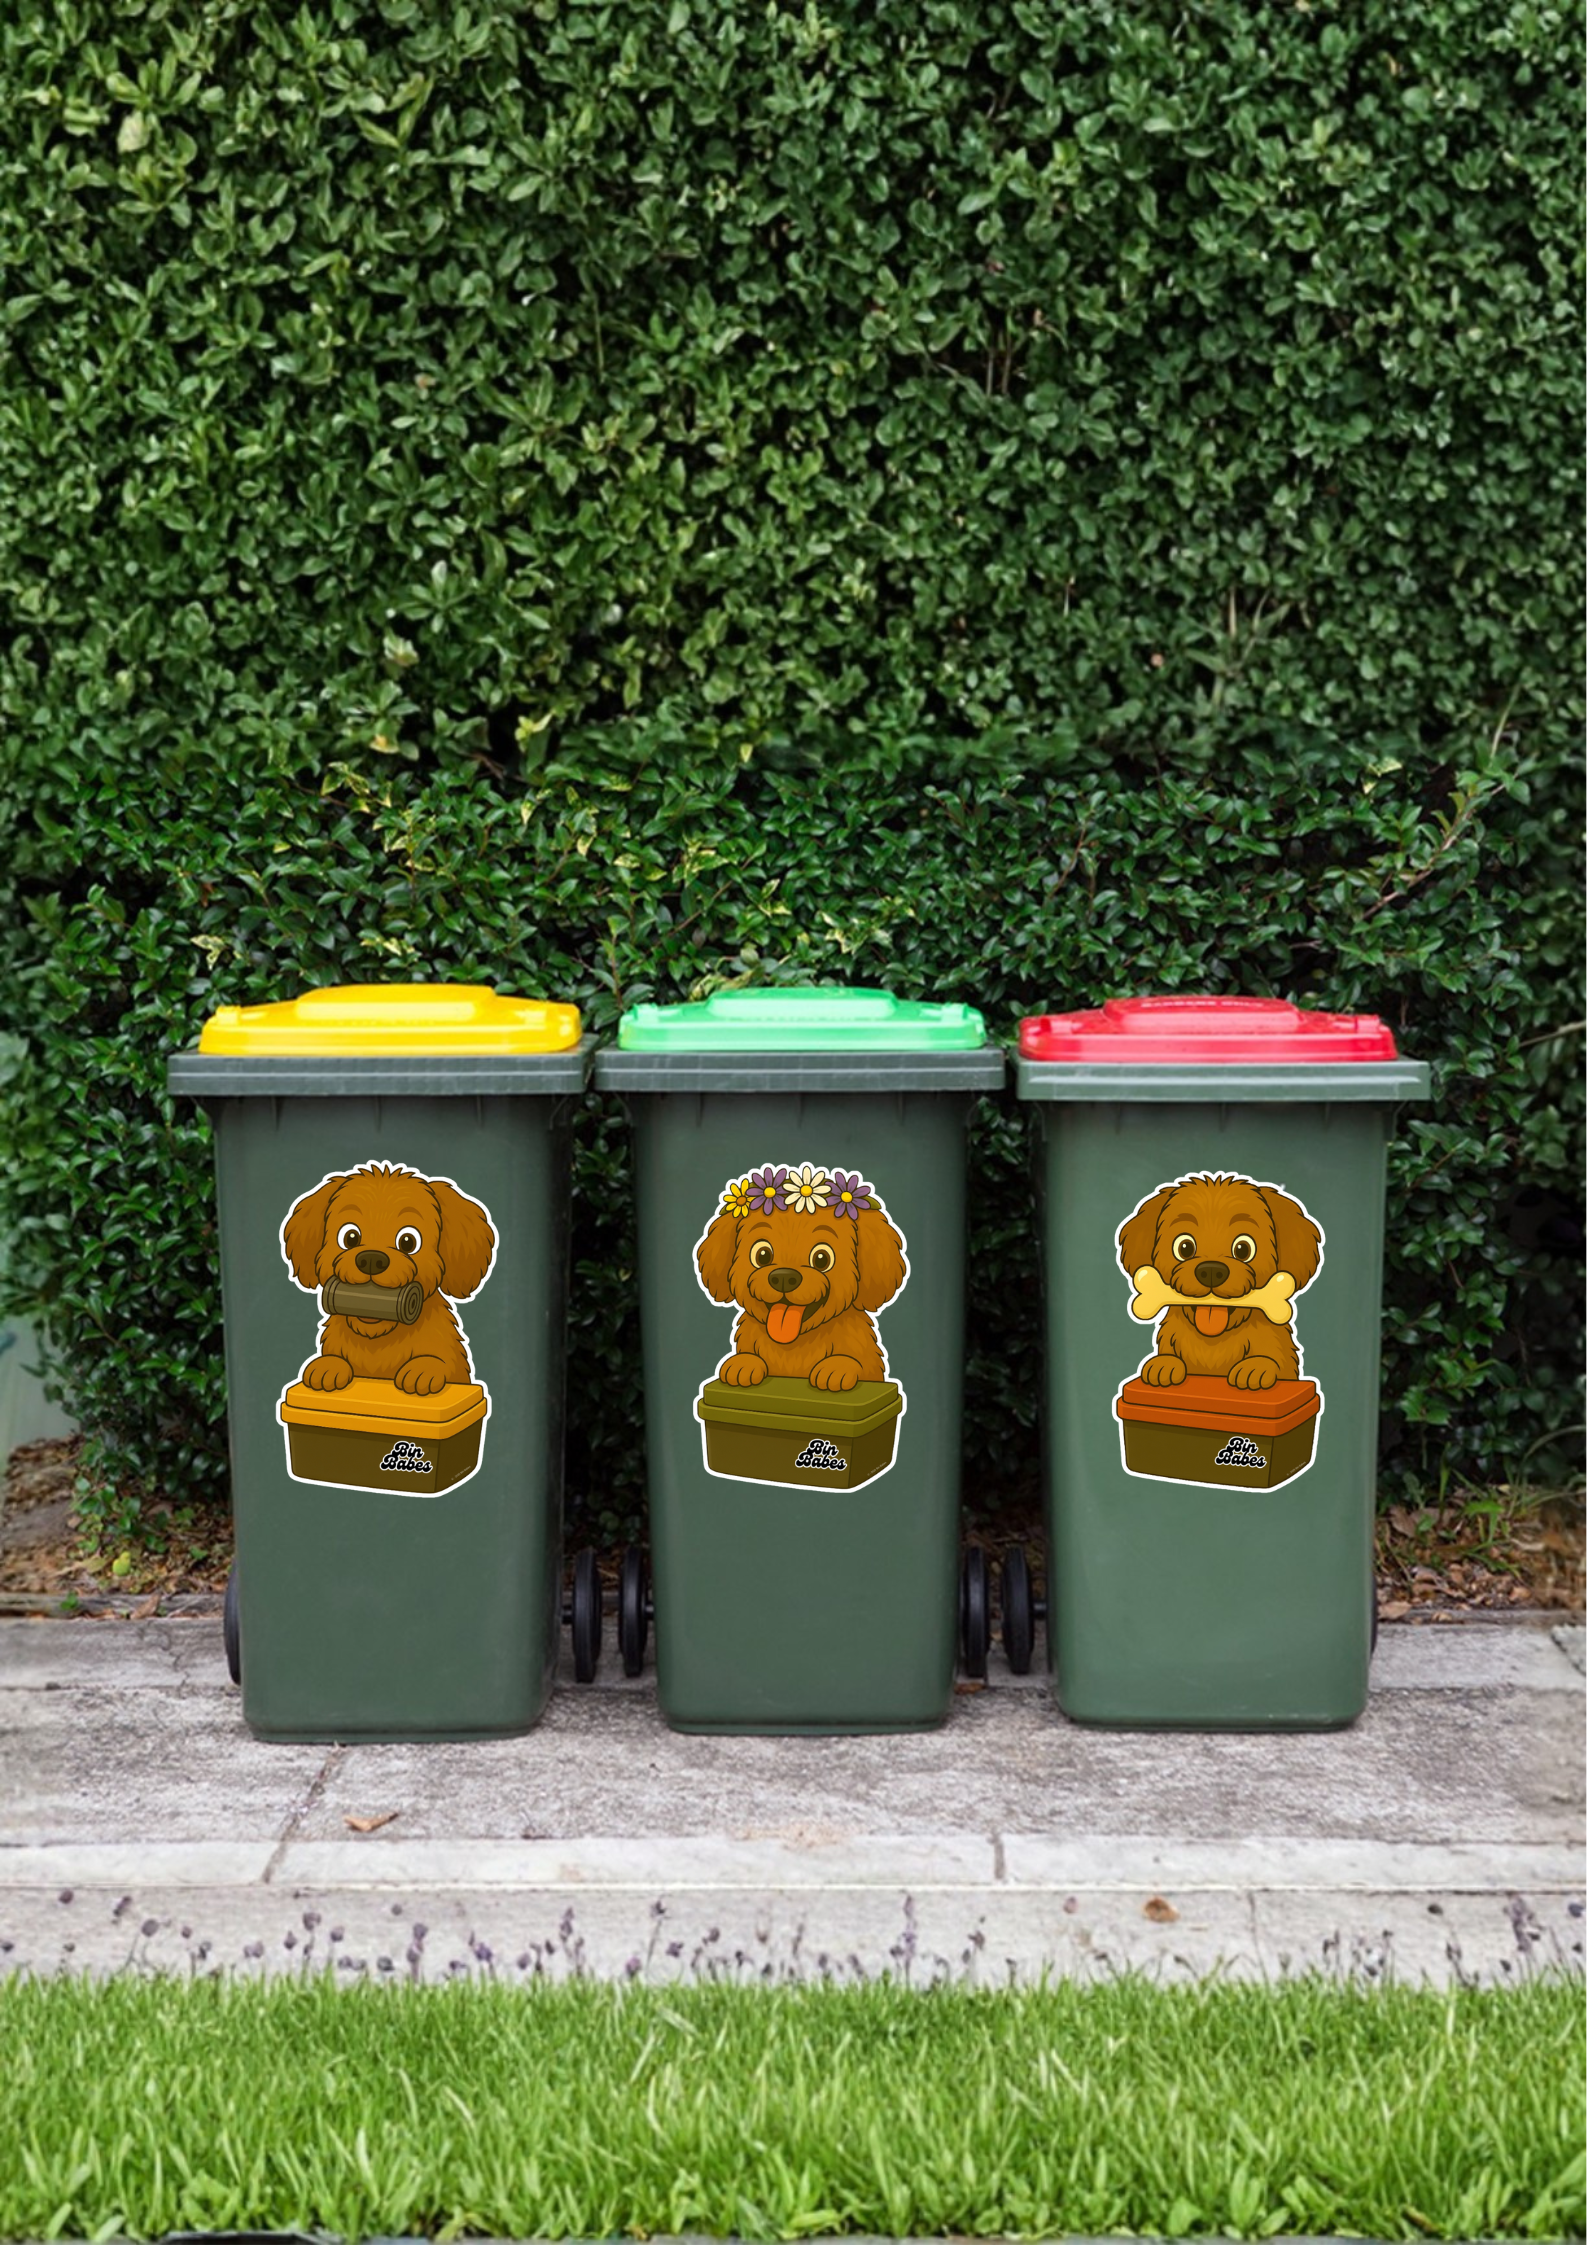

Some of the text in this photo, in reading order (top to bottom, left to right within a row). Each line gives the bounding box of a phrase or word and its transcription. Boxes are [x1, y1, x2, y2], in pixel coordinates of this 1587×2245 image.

[391, 1441, 424, 1459] Bin
[806, 1439, 838, 1456] Bin
[1226, 1437, 1258, 1454] Bin
[380, 1454, 433, 1473] Babes
[795, 1451, 847, 1470] Babes
[1215, 1449, 1266, 1468] Babes
